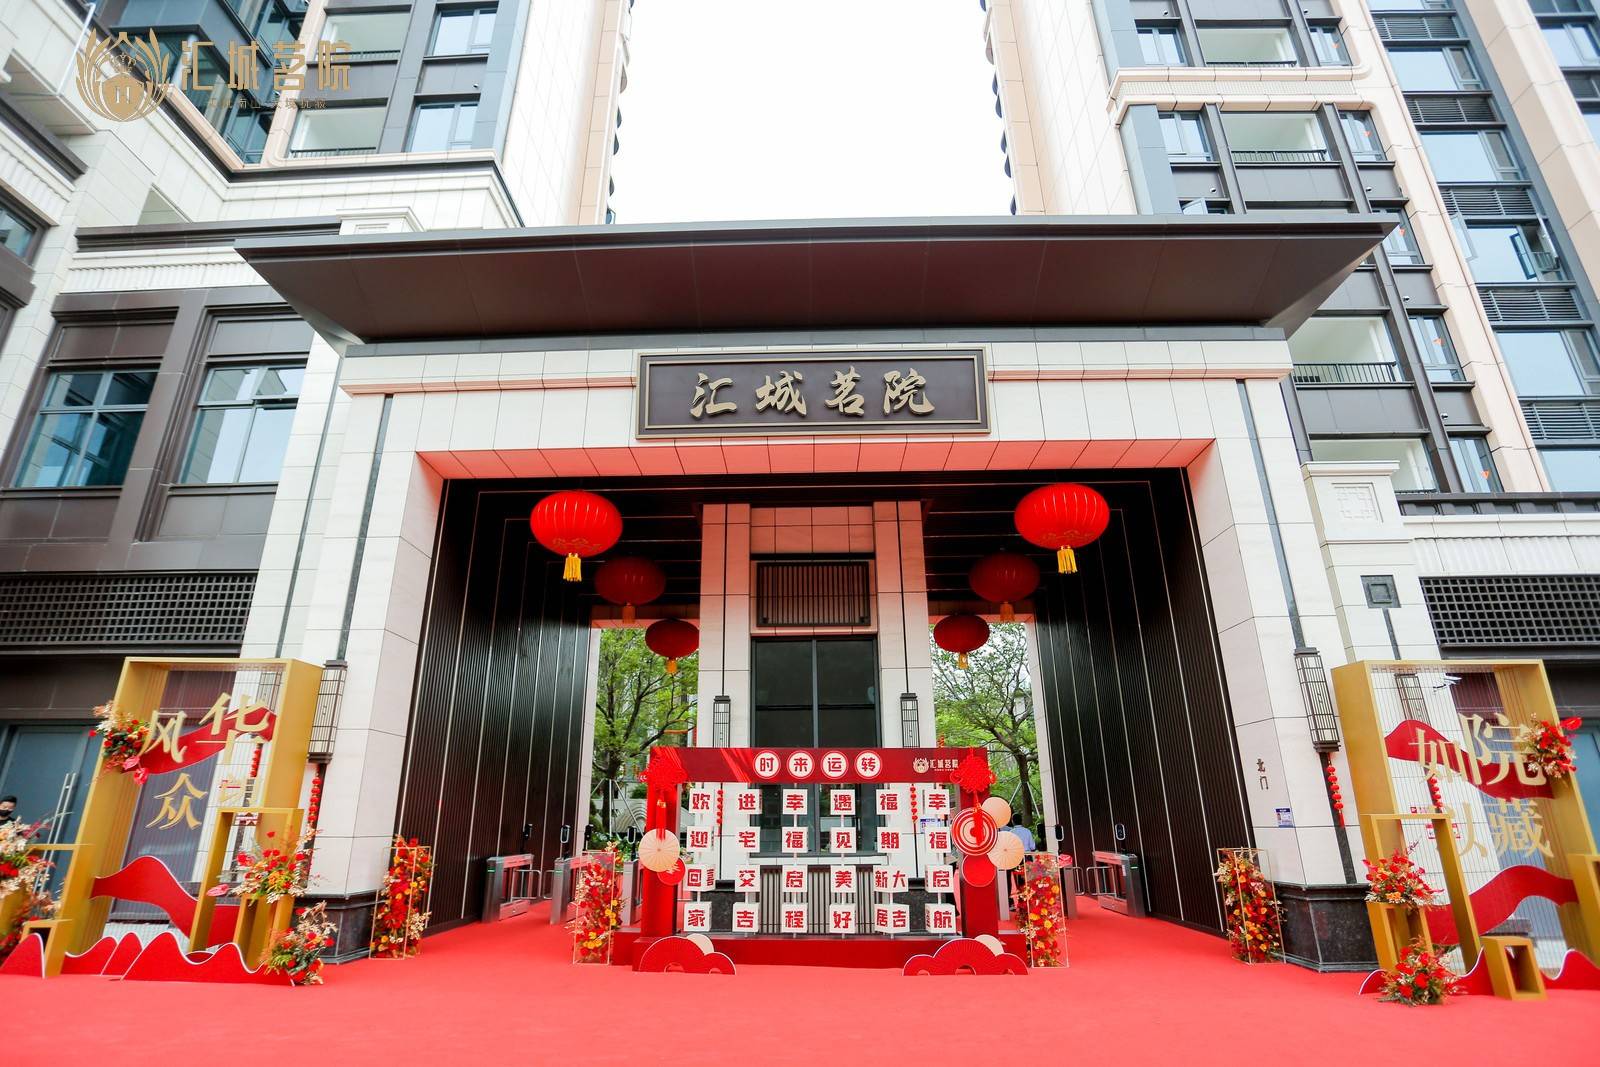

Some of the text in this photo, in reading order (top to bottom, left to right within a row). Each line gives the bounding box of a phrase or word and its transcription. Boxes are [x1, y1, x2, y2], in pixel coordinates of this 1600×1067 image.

[690, 366, 936, 418] 汇城茗院
[137, 692, 273, 765] 风华
[759, 757, 876, 772] 时来运转
[1408, 713, 1547, 786] 如院
[1256, 758, 1268, 790] 北门
[785, 794, 804, 928] 幸福启程
[833, 794, 852, 929] 遇见美好
